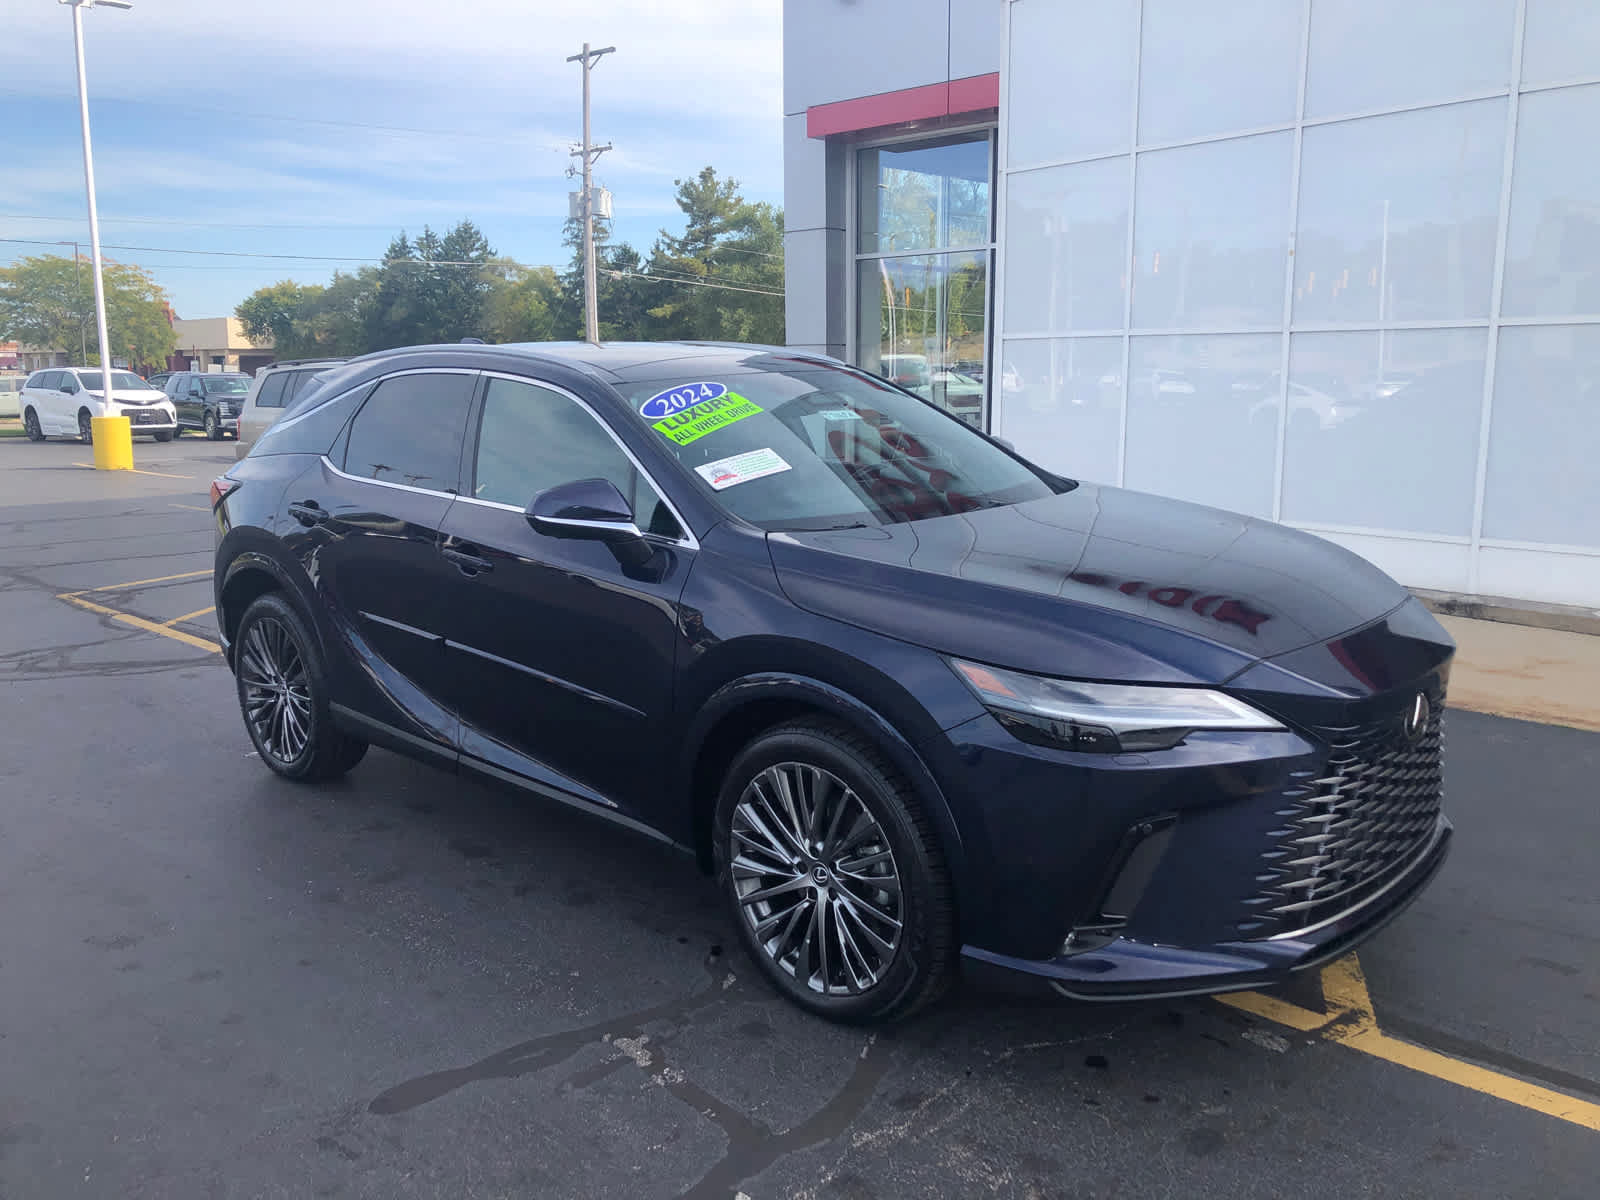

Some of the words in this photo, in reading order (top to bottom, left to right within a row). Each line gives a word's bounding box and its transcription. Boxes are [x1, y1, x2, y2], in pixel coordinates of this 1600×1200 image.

[656, 383, 713, 415] 2024
[661, 394, 736, 430] LUXURY
[673, 429, 697, 442] ALL
[693, 414, 729, 432] WHEEL
[725, 402, 756, 418] DRIVE
